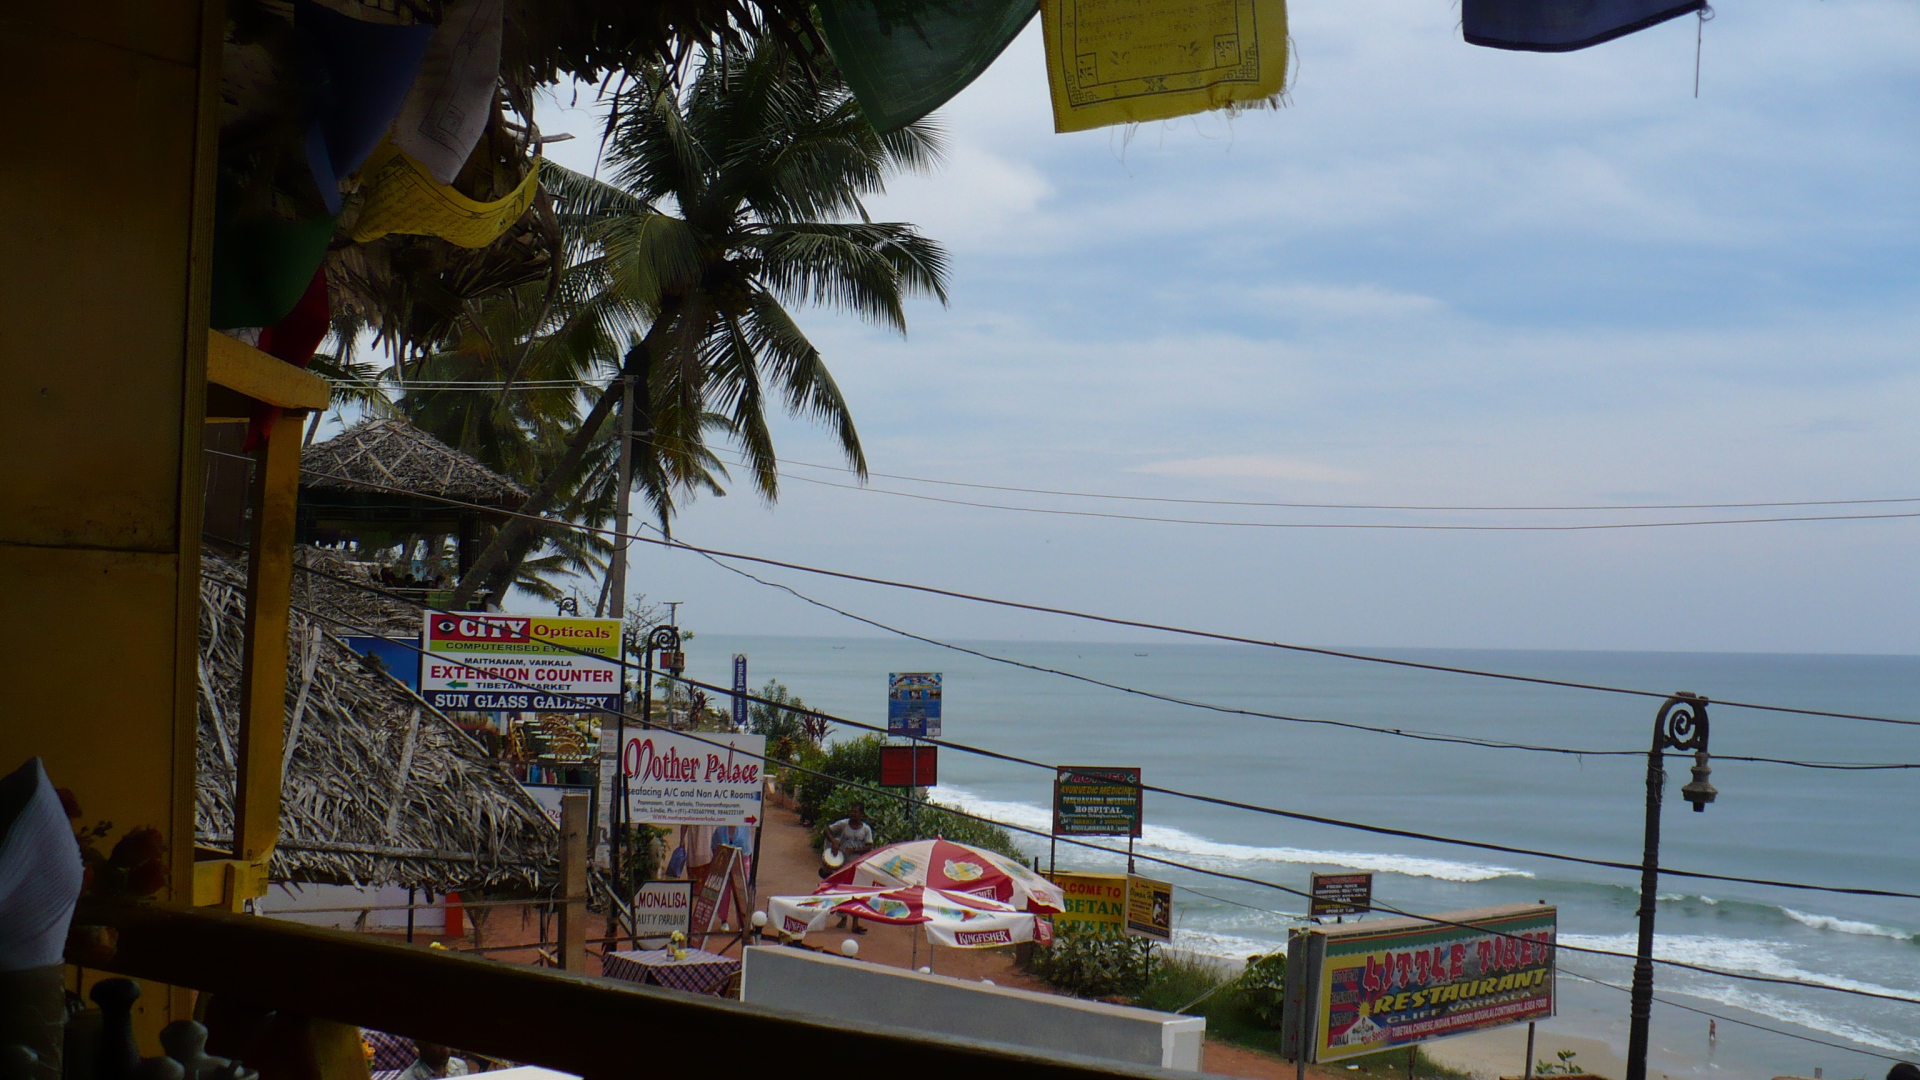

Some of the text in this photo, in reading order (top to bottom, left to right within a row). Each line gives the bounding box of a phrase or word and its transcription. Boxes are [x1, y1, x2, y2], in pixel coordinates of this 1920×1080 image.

[534, 624, 610, 639] Opticals
[446, 642, 540, 652] COMPUTERISED
[464, 657, 572, 667] MAITHANAM, VARKALA
[431, 665, 613, 682] EXTENSION COUNTER
[435, 694, 469, 708] SUN
[474, 695, 528, 709] GLASS
[533, 695, 608, 710] GALLERY
[623, 738, 701, 783] Mother
[704, 741, 759, 783] Palace
[664, 788, 679, 797] A/C
[680, 788, 695, 797] and
[696, 789, 712, 798] Non
[714, 789, 729, 799] A/C
[730, 790, 754, 799] Rooms
[1075, 806, 1123, 814] HOSPITAL
[1054, 882, 1122, 899] ELCOME TO
[639, 891, 687, 908] MONALISA
[1063, 898, 1123, 916] BETAN
[658, 914, 686, 925] PARLOUR
[958, 930, 1010, 944] KINGFISHER
[1363, 932, 1549, 991] LITTLE TIBET
[1373, 968, 1547, 1014] RESTAURANT
[1386, 993, 1531, 1024] CLIFF VARKALA
